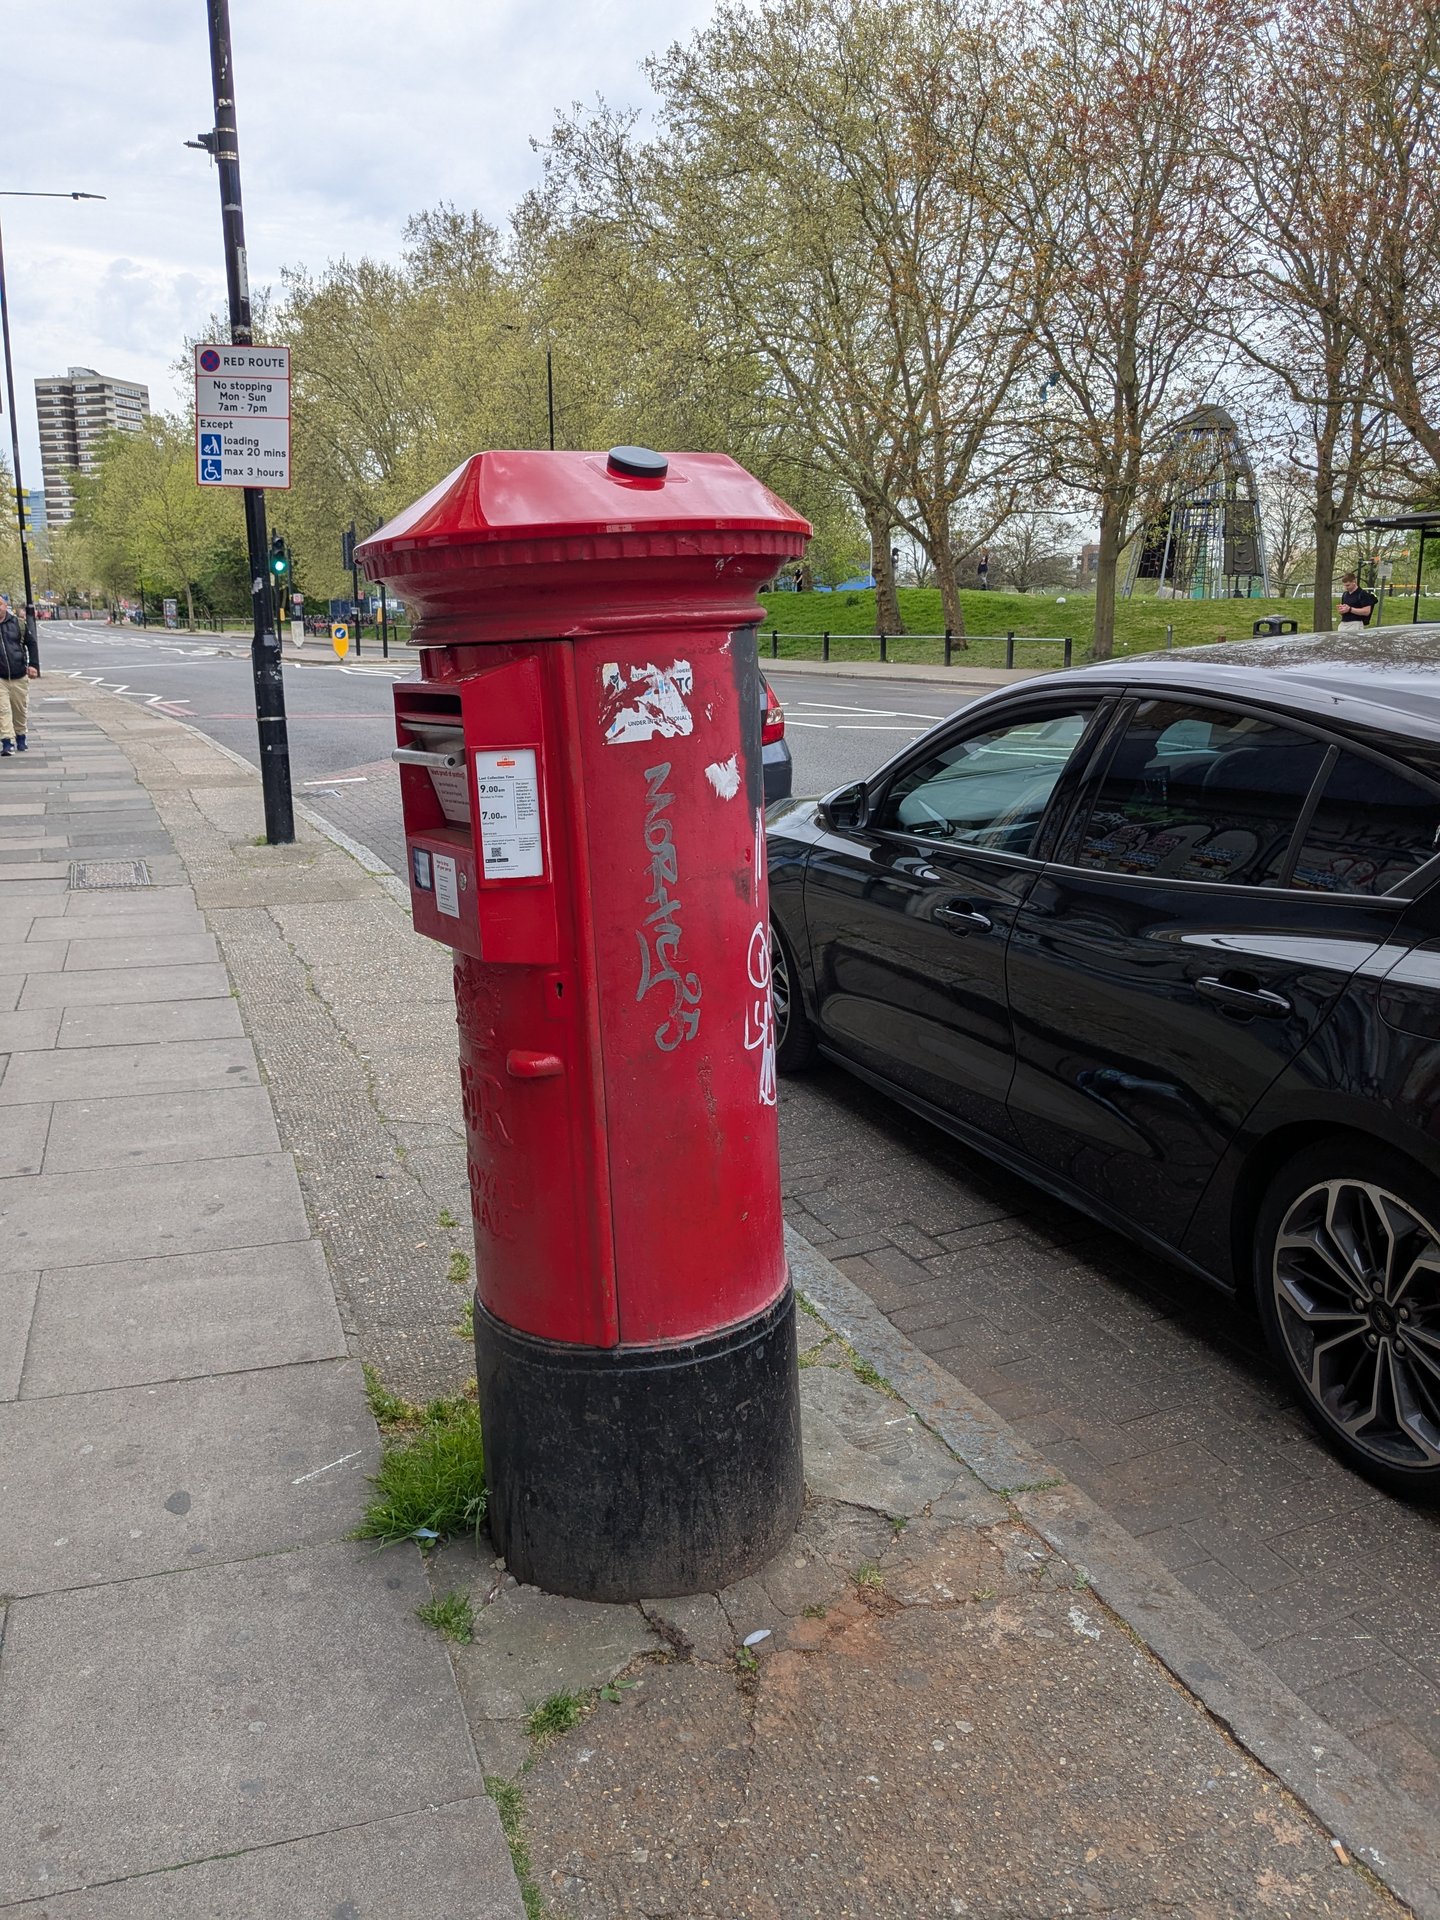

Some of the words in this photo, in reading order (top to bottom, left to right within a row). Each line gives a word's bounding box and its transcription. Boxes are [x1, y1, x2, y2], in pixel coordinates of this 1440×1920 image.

[223, 357, 245, 366] RED
[248, 358, 285, 368] ROUTE
[213, 381, 227, 390] No
[230, 381, 272, 392] stopping
[220, 392, 240, 401] Mon
[248, 393, 266, 402] Sun
[218, 403, 238, 412] 7am
[247, 404, 268, 414] 7pm
[200, 420, 233, 430] Except
[224, 436, 259, 447] loading
[224, 448, 244, 456] max
[247, 448, 260, 457] 20
[264, 449, 286, 458] mins
[224, 468, 244, 476] max
[247, 467, 254, 476] 3
[257, 467, 284, 477] hours
[480, 784, 506, 794] 9.00am
[482, 811, 508, 820] 7.00am
